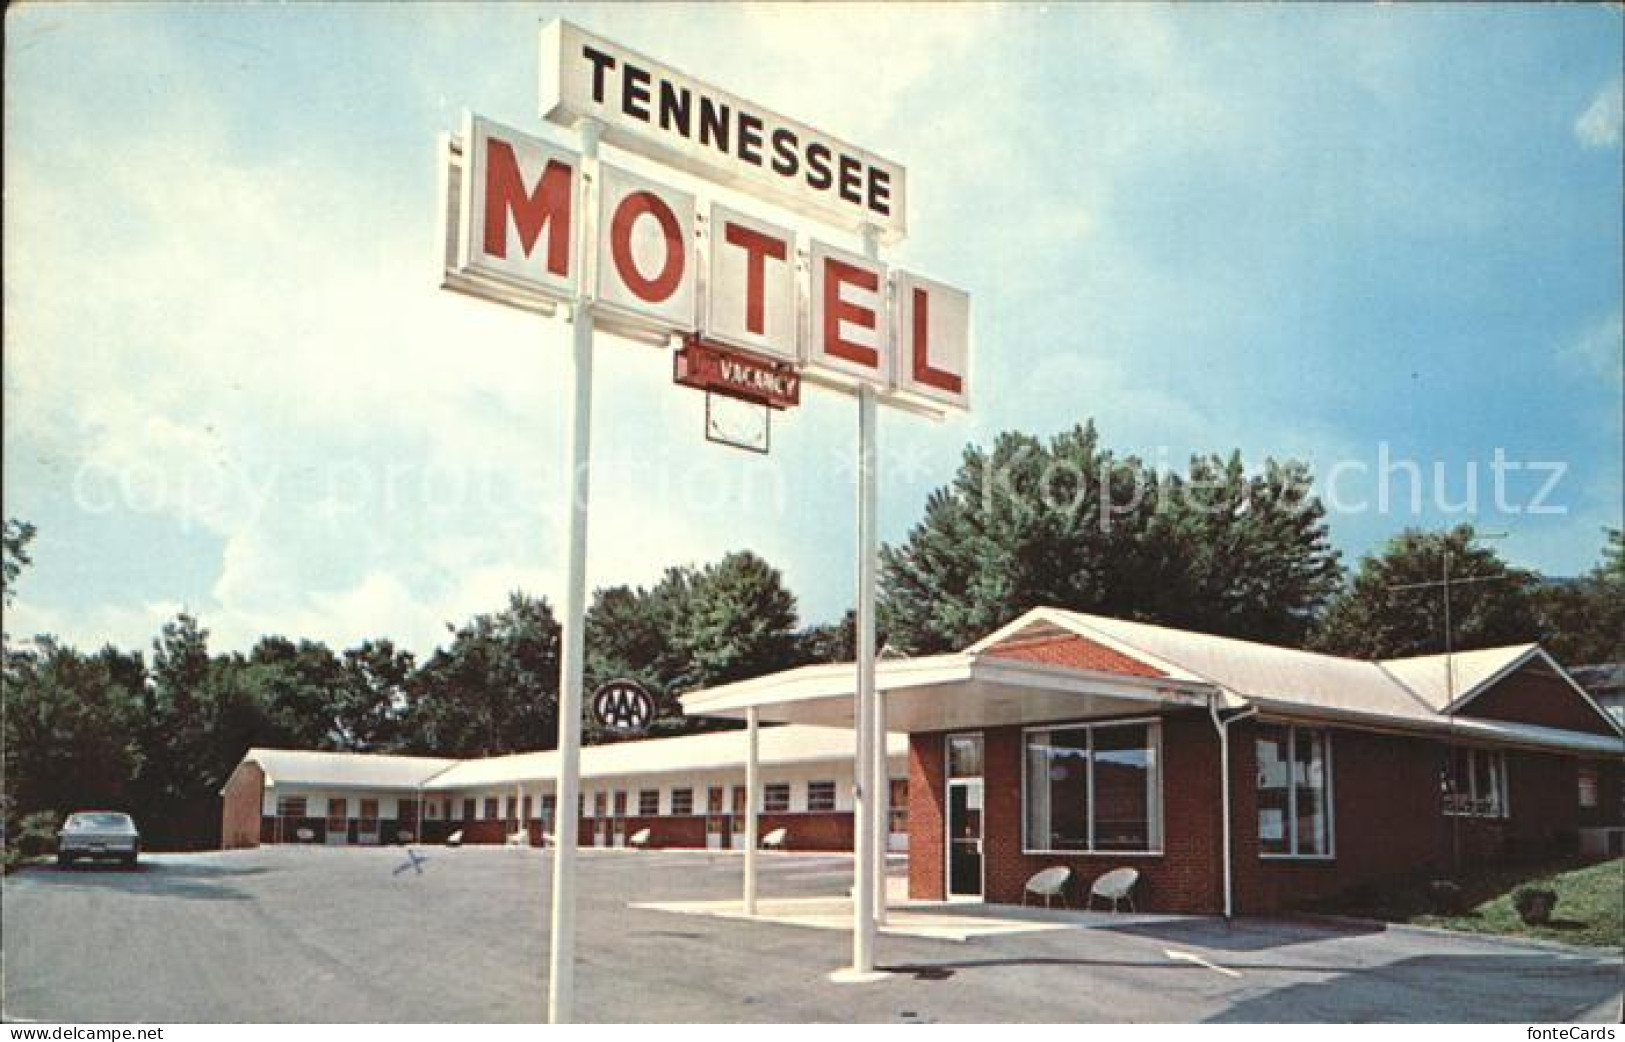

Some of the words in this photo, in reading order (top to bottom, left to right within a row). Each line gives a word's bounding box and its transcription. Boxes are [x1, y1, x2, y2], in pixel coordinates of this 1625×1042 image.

[582, 45, 891, 216] TENNESSEE
[483, 137, 962, 394] MOTEL
[720, 359, 797, 397] VACANCY
[598, 690, 647, 727] AAA
